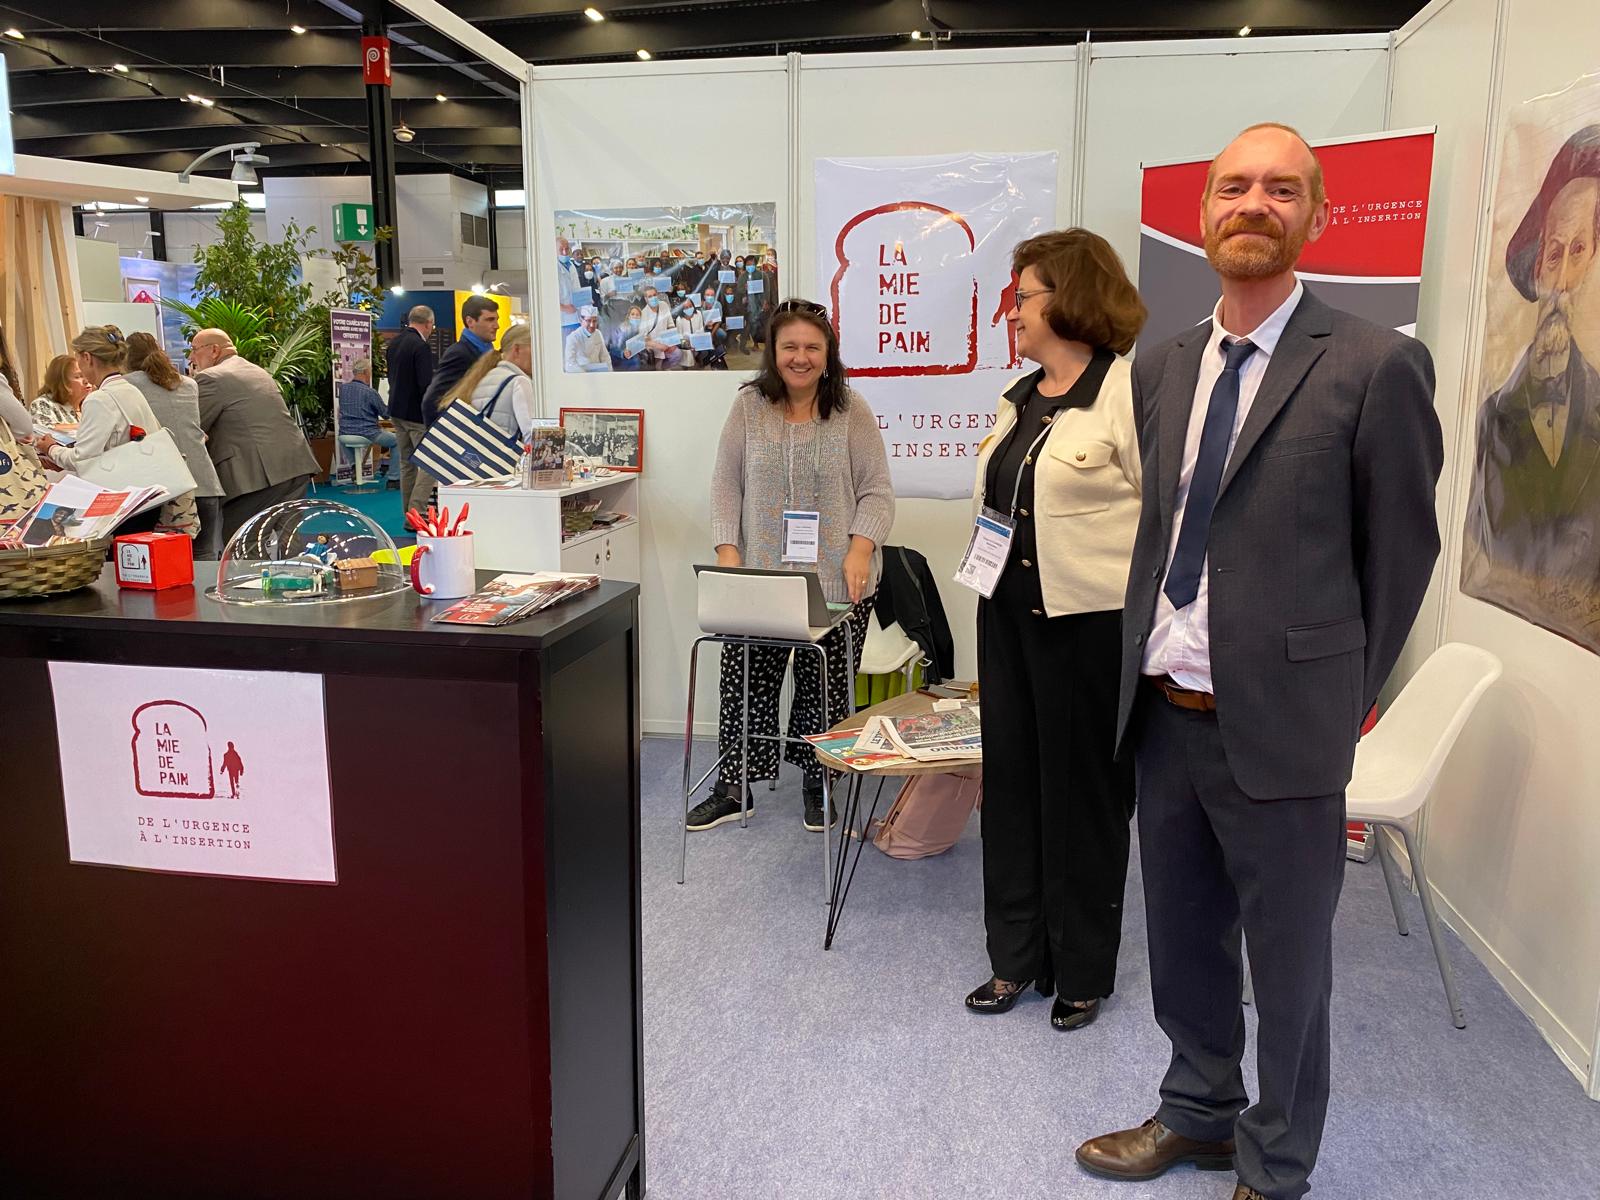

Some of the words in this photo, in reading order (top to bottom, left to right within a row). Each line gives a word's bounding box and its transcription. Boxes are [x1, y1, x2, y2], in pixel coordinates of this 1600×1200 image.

[1333, 206, 1346, 214] DE
[1352, 201, 1422, 212] L'URGENCE
[1343, 213, 1421, 224] L'INSERTION
[879, 244, 907, 266] LA
[879, 272, 919, 295] MIE
[879, 302, 907, 325] DE
[878, 331, 930, 353] PAIN
[876, 413, 997, 430] L'URGEN
[892, 443, 980, 458] INSERT
[155, 722, 172, 736] LA
[157, 738, 181, 753] MIE
[158, 755, 175, 769] DE
[160, 771, 189, 786] PAIN
[138, 816, 154, 827] DE
[163, 818, 250, 834] L'URGENCE
[139, 831, 147, 842] À
[154, 834, 251, 850] L'INSERTION
